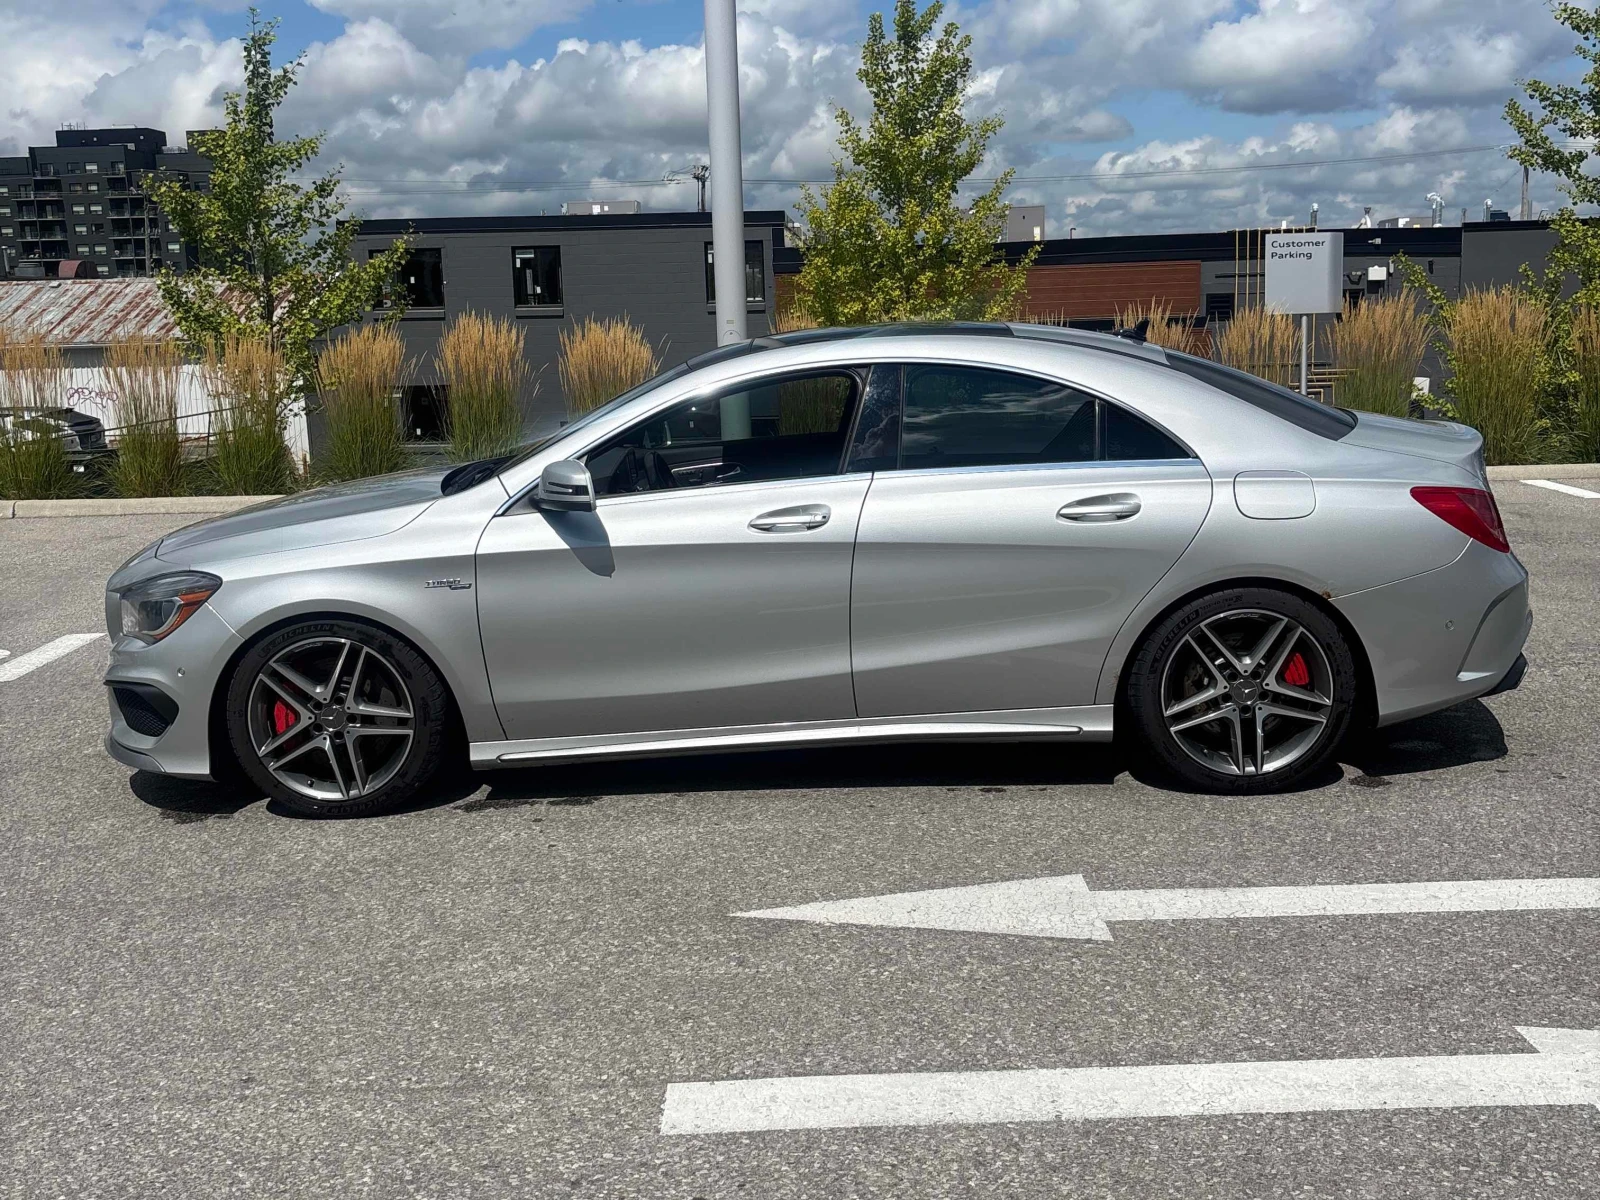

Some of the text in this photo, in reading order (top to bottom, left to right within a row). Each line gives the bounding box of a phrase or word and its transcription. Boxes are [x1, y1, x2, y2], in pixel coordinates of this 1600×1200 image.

[1271, 240, 1326, 249] Customer
[1271, 251, 1313, 260] Parking
[275, 624, 331, 645] MICHELIN
[1155, 611, 1196, 660] MICHELIN
